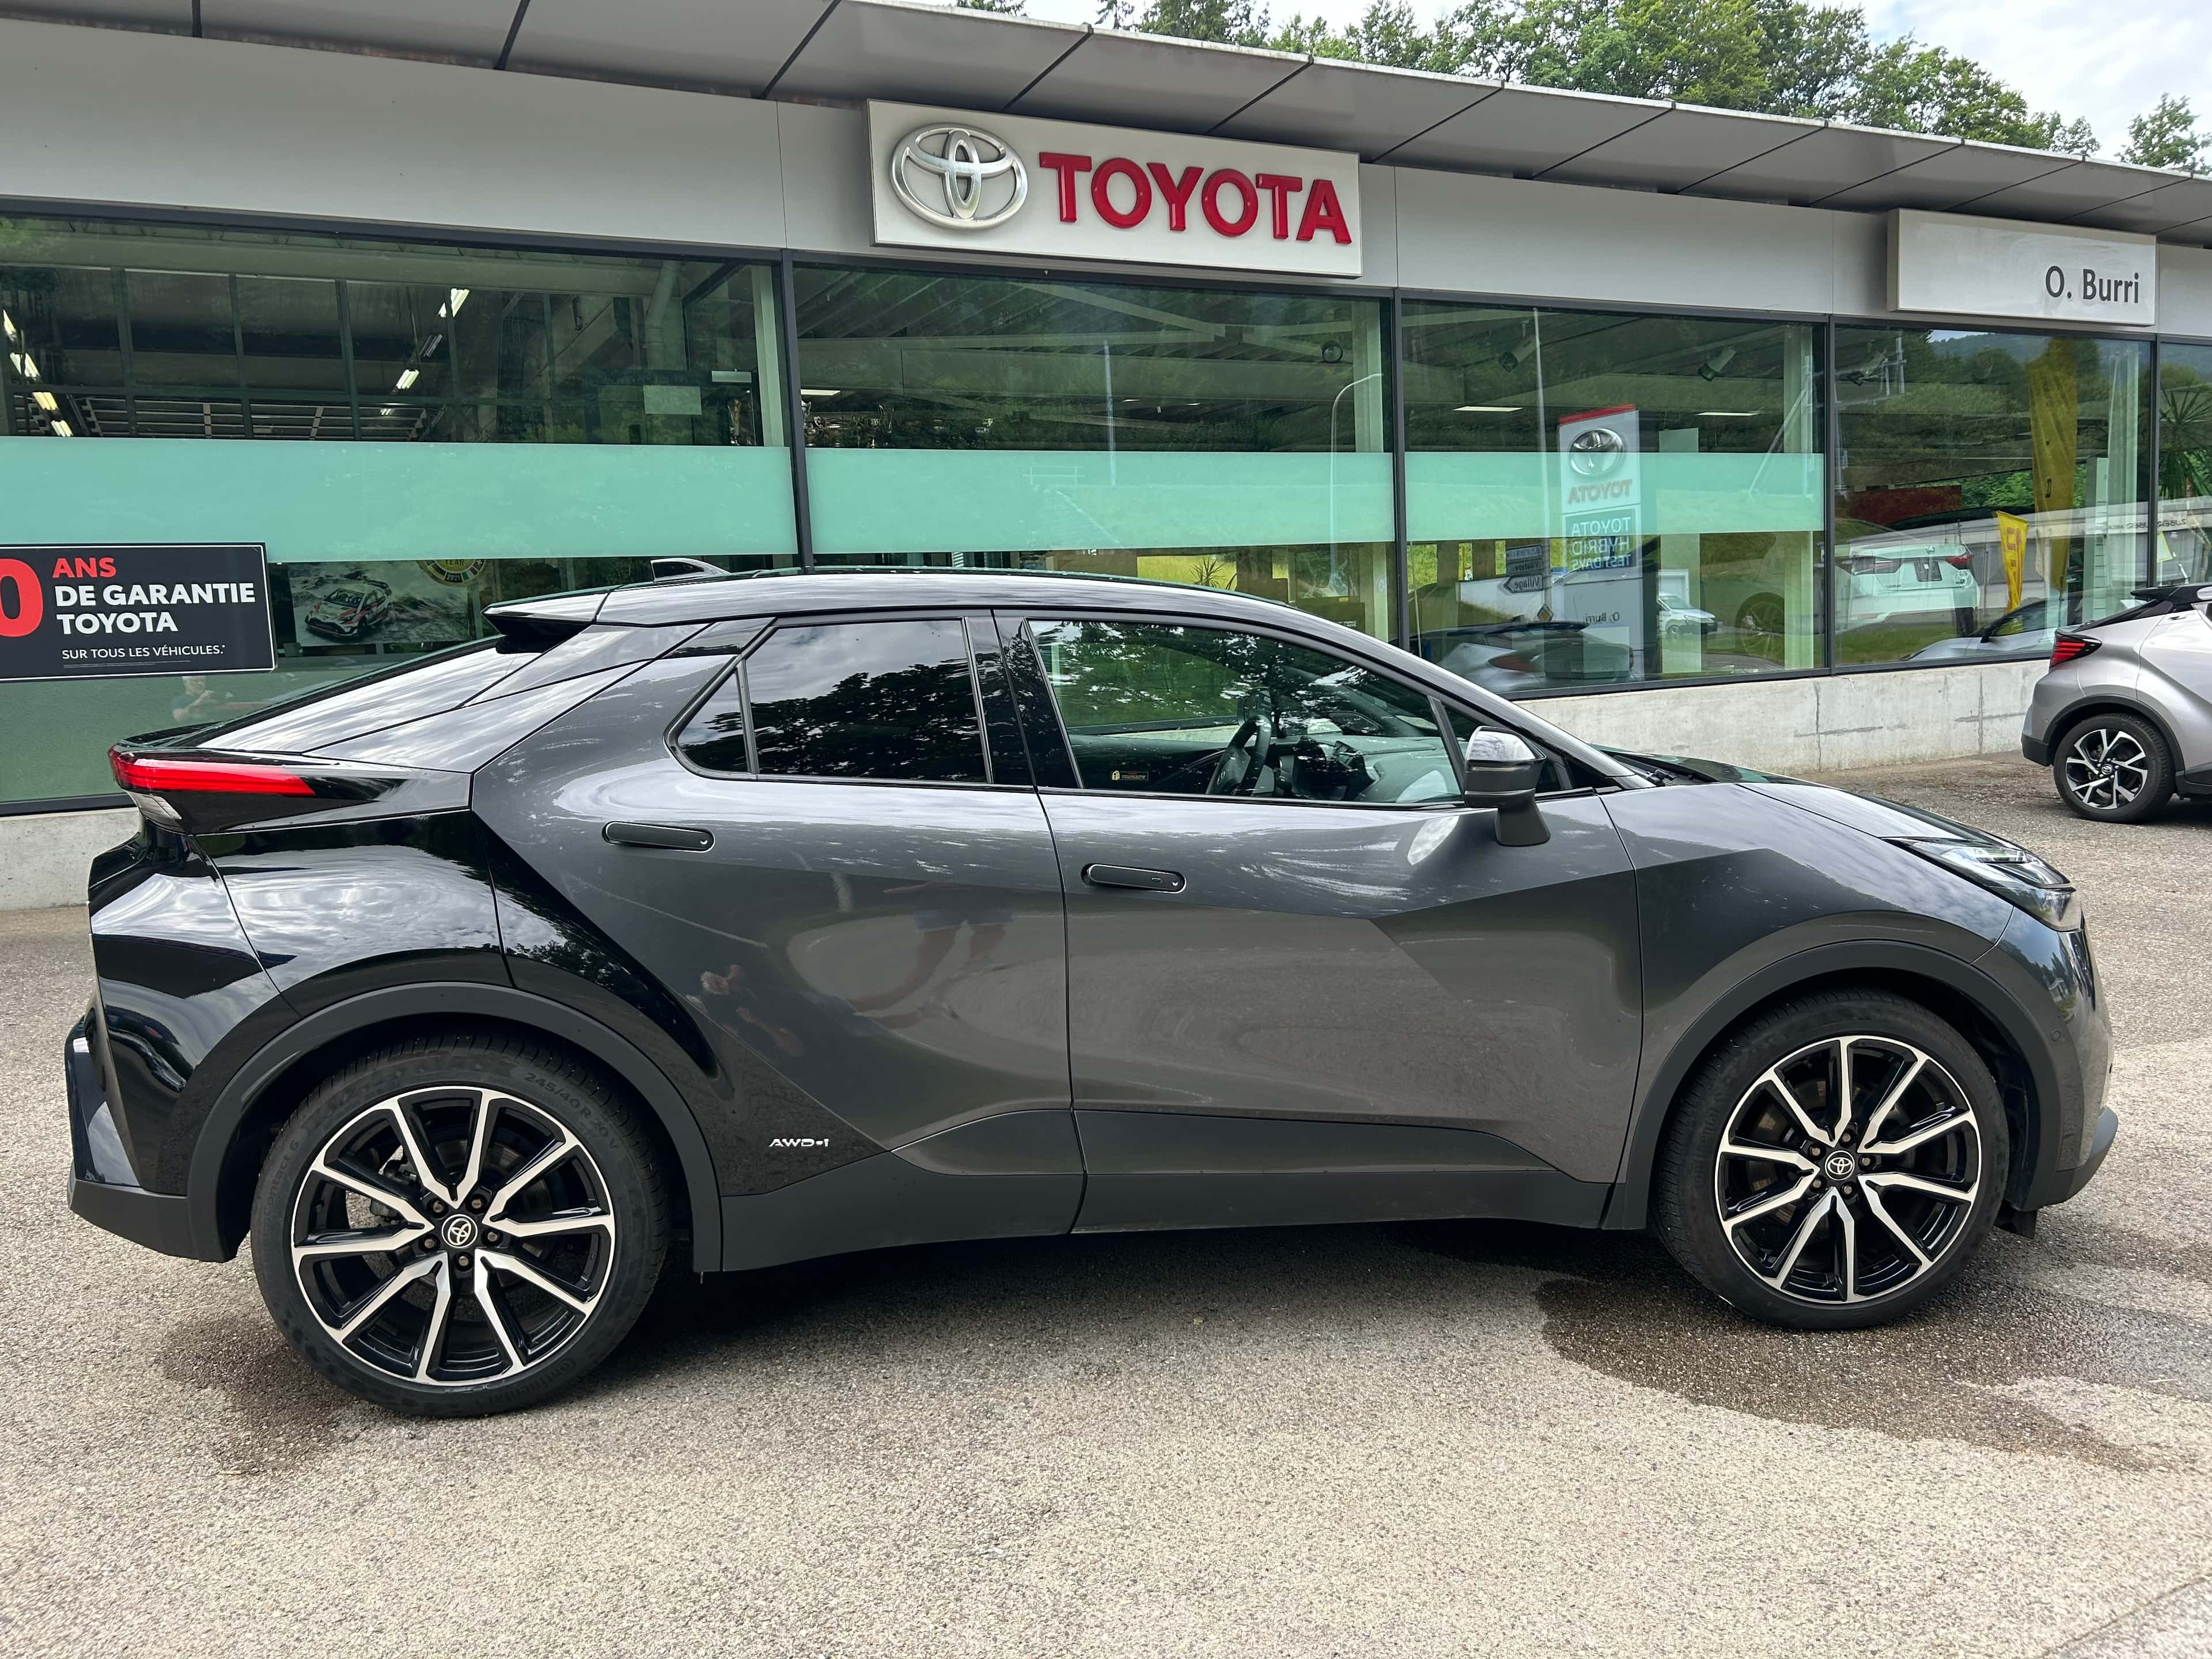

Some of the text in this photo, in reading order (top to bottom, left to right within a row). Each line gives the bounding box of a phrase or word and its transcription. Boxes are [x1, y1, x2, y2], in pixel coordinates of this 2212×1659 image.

[1039, 151, 1352, 245] TOYOTA
[2045, 266, 2139, 304] O. Burri
[52, 557, 116, 578] ANS
[55, 582, 256, 607] DE GARANTIE
[56, 612, 179, 635] TOYOTA
[62, 649, 88, 660] SUR
[90, 648, 126, 658] TOUS
[128, 647, 150, 657] LES
[524, 1071, 581, 1109] 245/40
